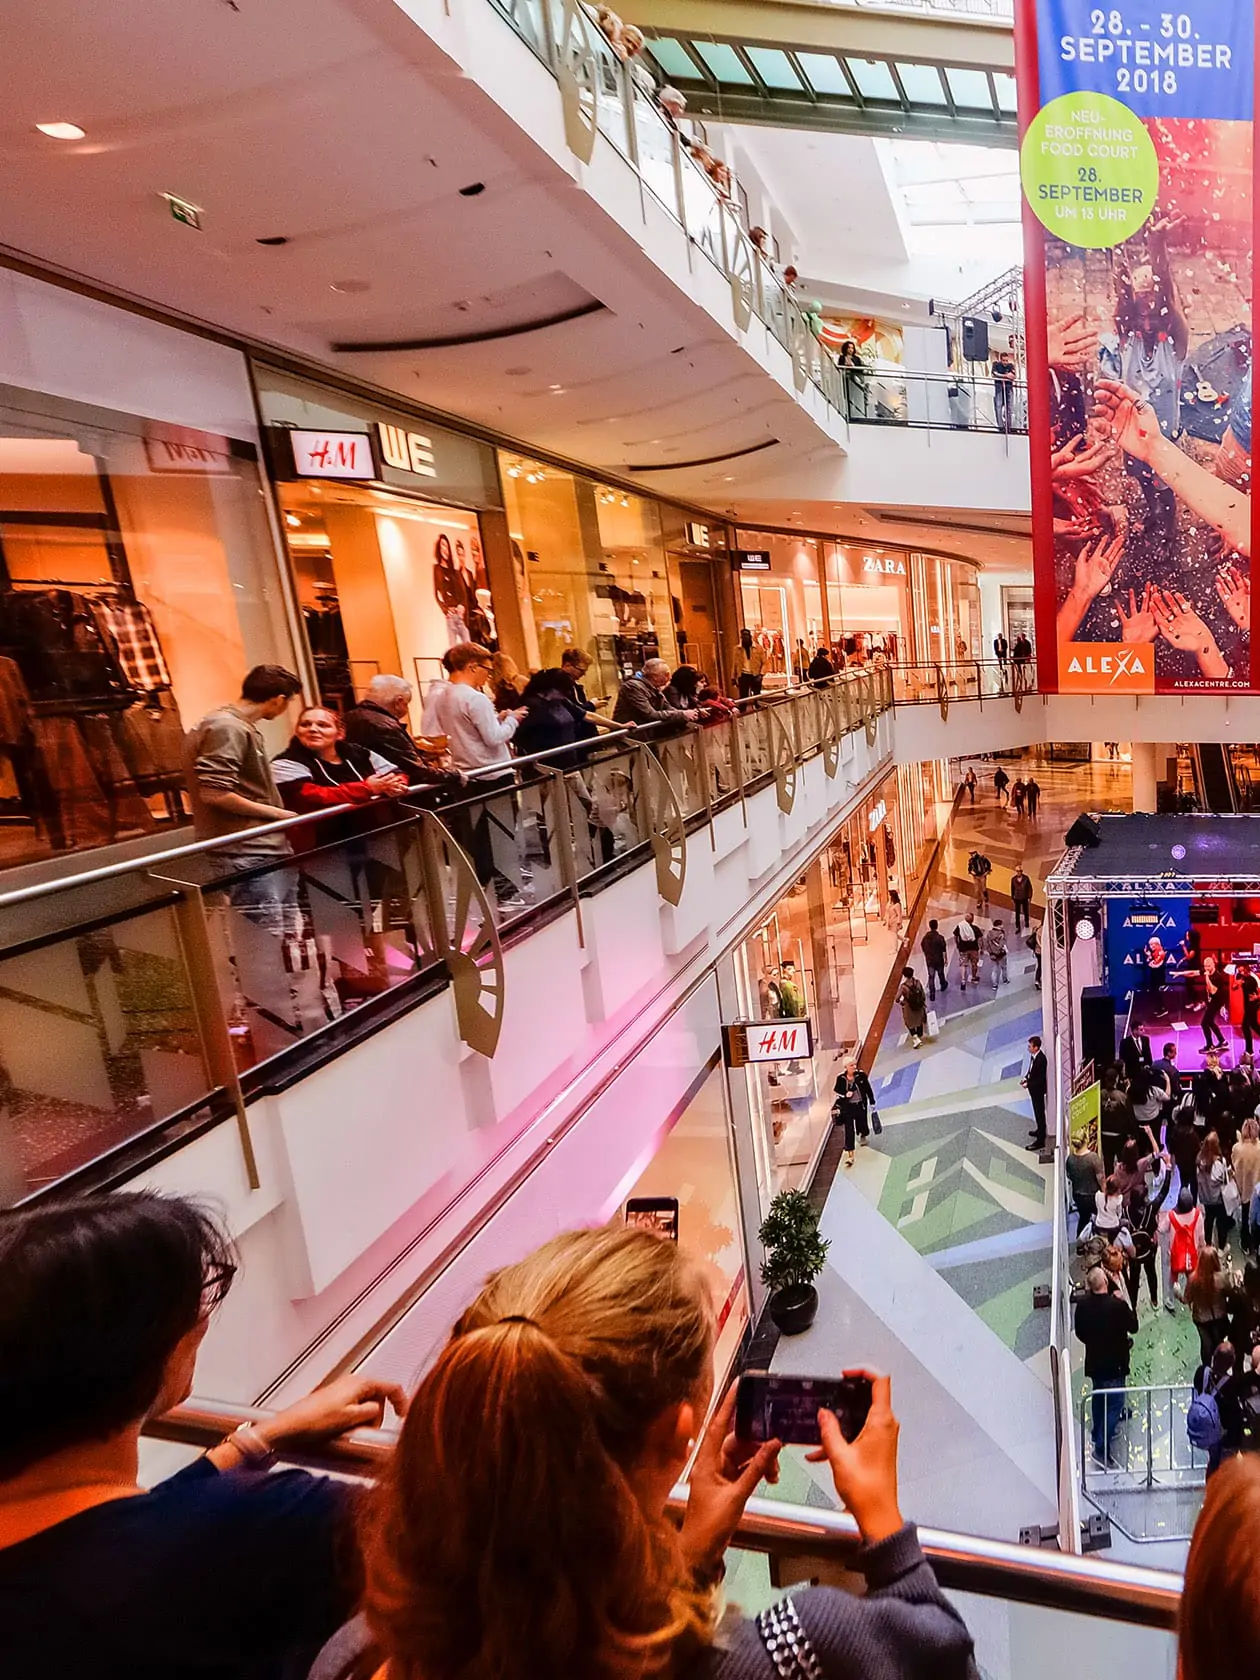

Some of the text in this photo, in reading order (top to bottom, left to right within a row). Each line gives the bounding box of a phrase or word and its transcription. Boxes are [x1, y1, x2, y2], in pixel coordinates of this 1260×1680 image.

[1090, 9, 1131, 35] 28.
[1160, 13, 1200, 39] 30.
[1060, 36, 1232, 69] SEPTEMBER
[1116, 68, 1178, 94] 2018
[1041, 141, 1138, 159] FOOD COURT
[1078, 166, 1102, 182] 28.
[1038, 184, 1143, 203] SEPTEMBER
[1055, 204, 1077, 218] UM
[1098, 205, 1127, 221] UHR
[308, 439, 356, 470] H&M
[378, 422, 437, 478] WE
[863, 556, 906, 575] ZARA
[1068, 649, 1145, 686] ALEXA
[759, 1029, 797, 1053] H&M
